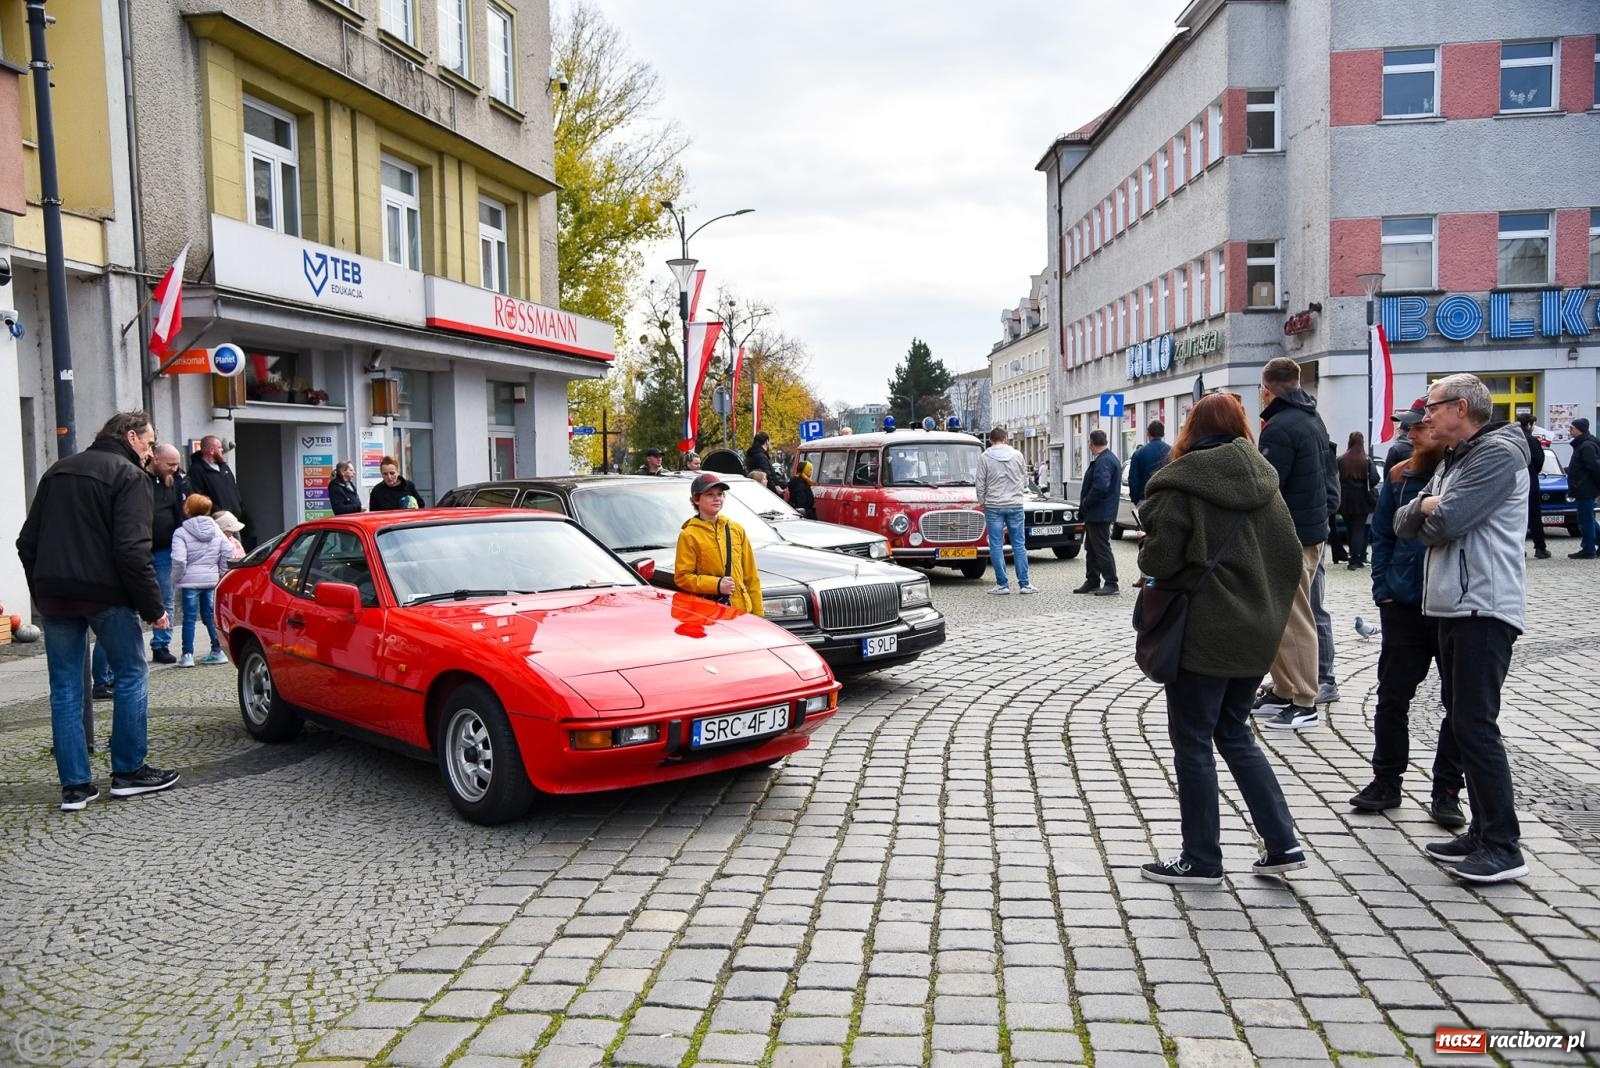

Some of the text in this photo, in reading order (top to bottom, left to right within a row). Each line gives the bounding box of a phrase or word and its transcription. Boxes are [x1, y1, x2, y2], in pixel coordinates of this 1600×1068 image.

[330, 256, 362, 285] TEB
[331, 284, 363, 298] EDUKACJA
[494, 295, 577, 342] ROSSMANN
[1380, 288, 1600, 343] BOLK
[868, 636, 896, 655] S 9LP
[704, 716, 742, 742] SRC
[747, 707, 787, 734] 4FJ3
